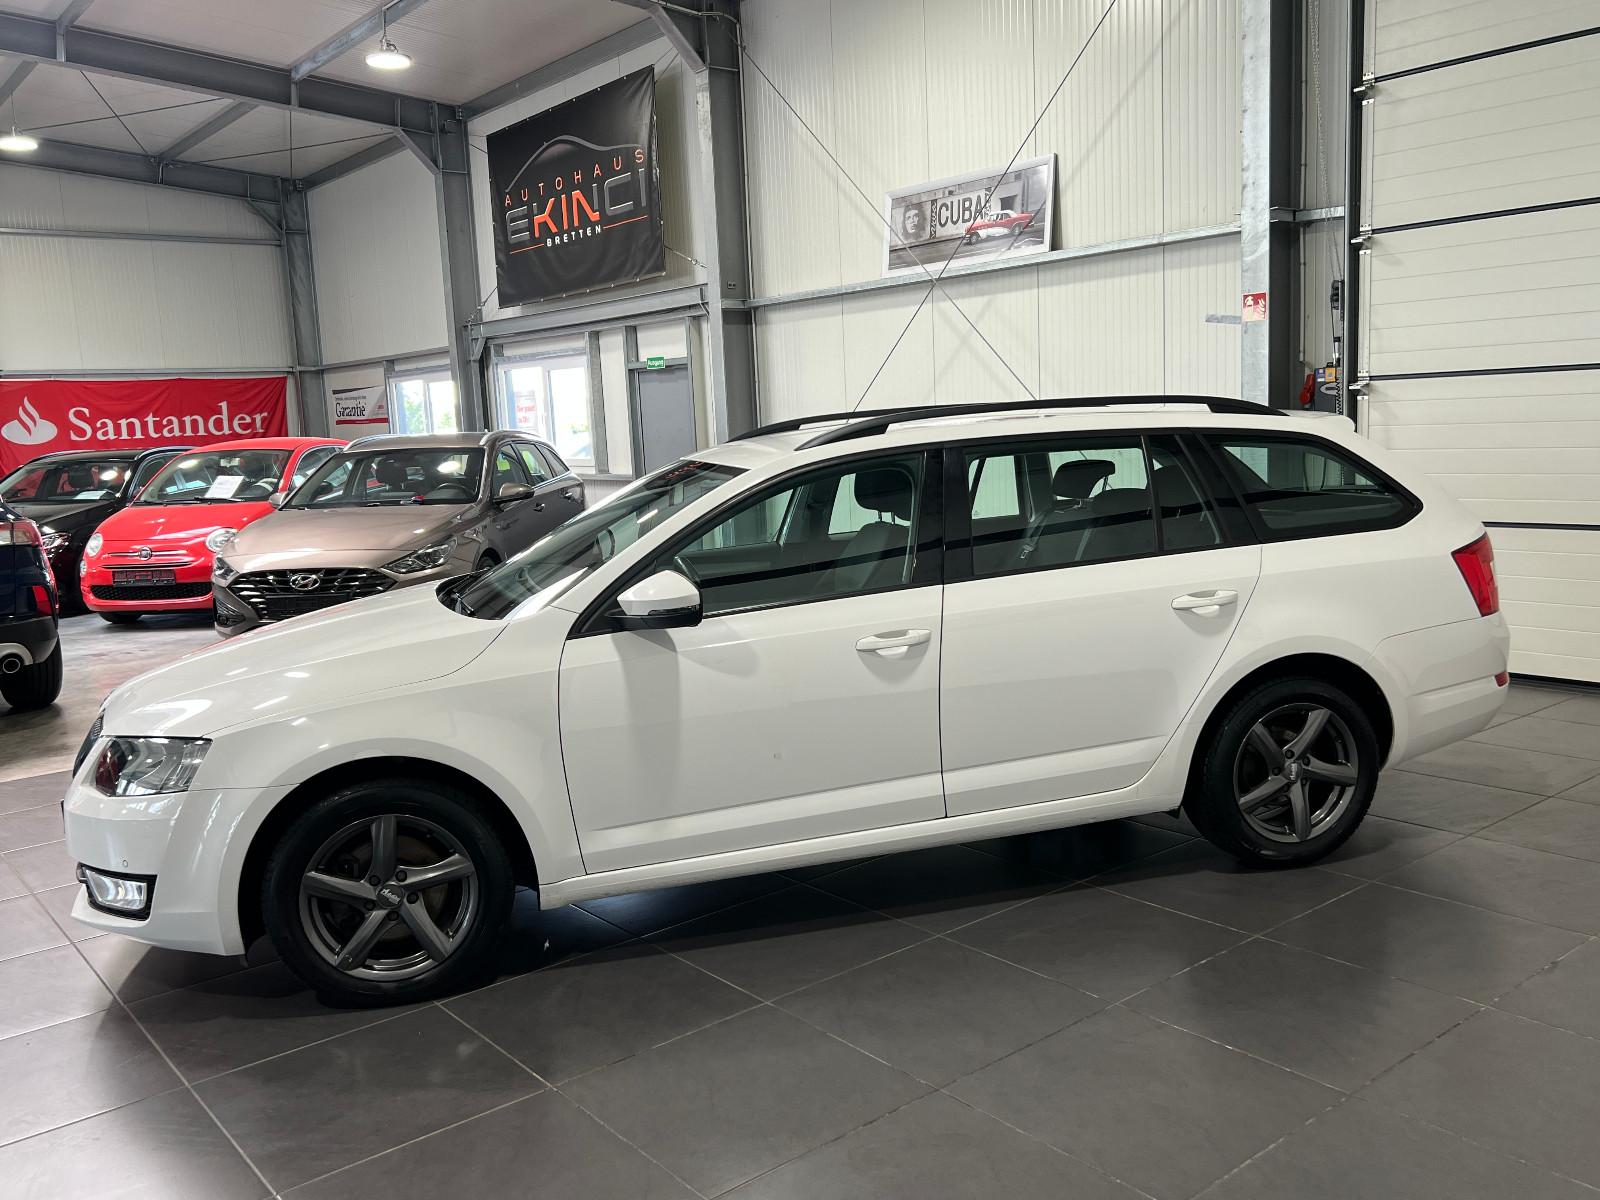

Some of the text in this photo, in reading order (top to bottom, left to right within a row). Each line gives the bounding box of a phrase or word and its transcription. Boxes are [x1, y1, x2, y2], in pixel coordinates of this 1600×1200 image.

[504, 149, 645, 207] AUTOHAUS
[505, 168, 647, 244] EKINCI
[937, 195, 984, 228] CUBA
[546, 224, 602, 247] BRETTEN
[67, 400, 268, 441] Santander
